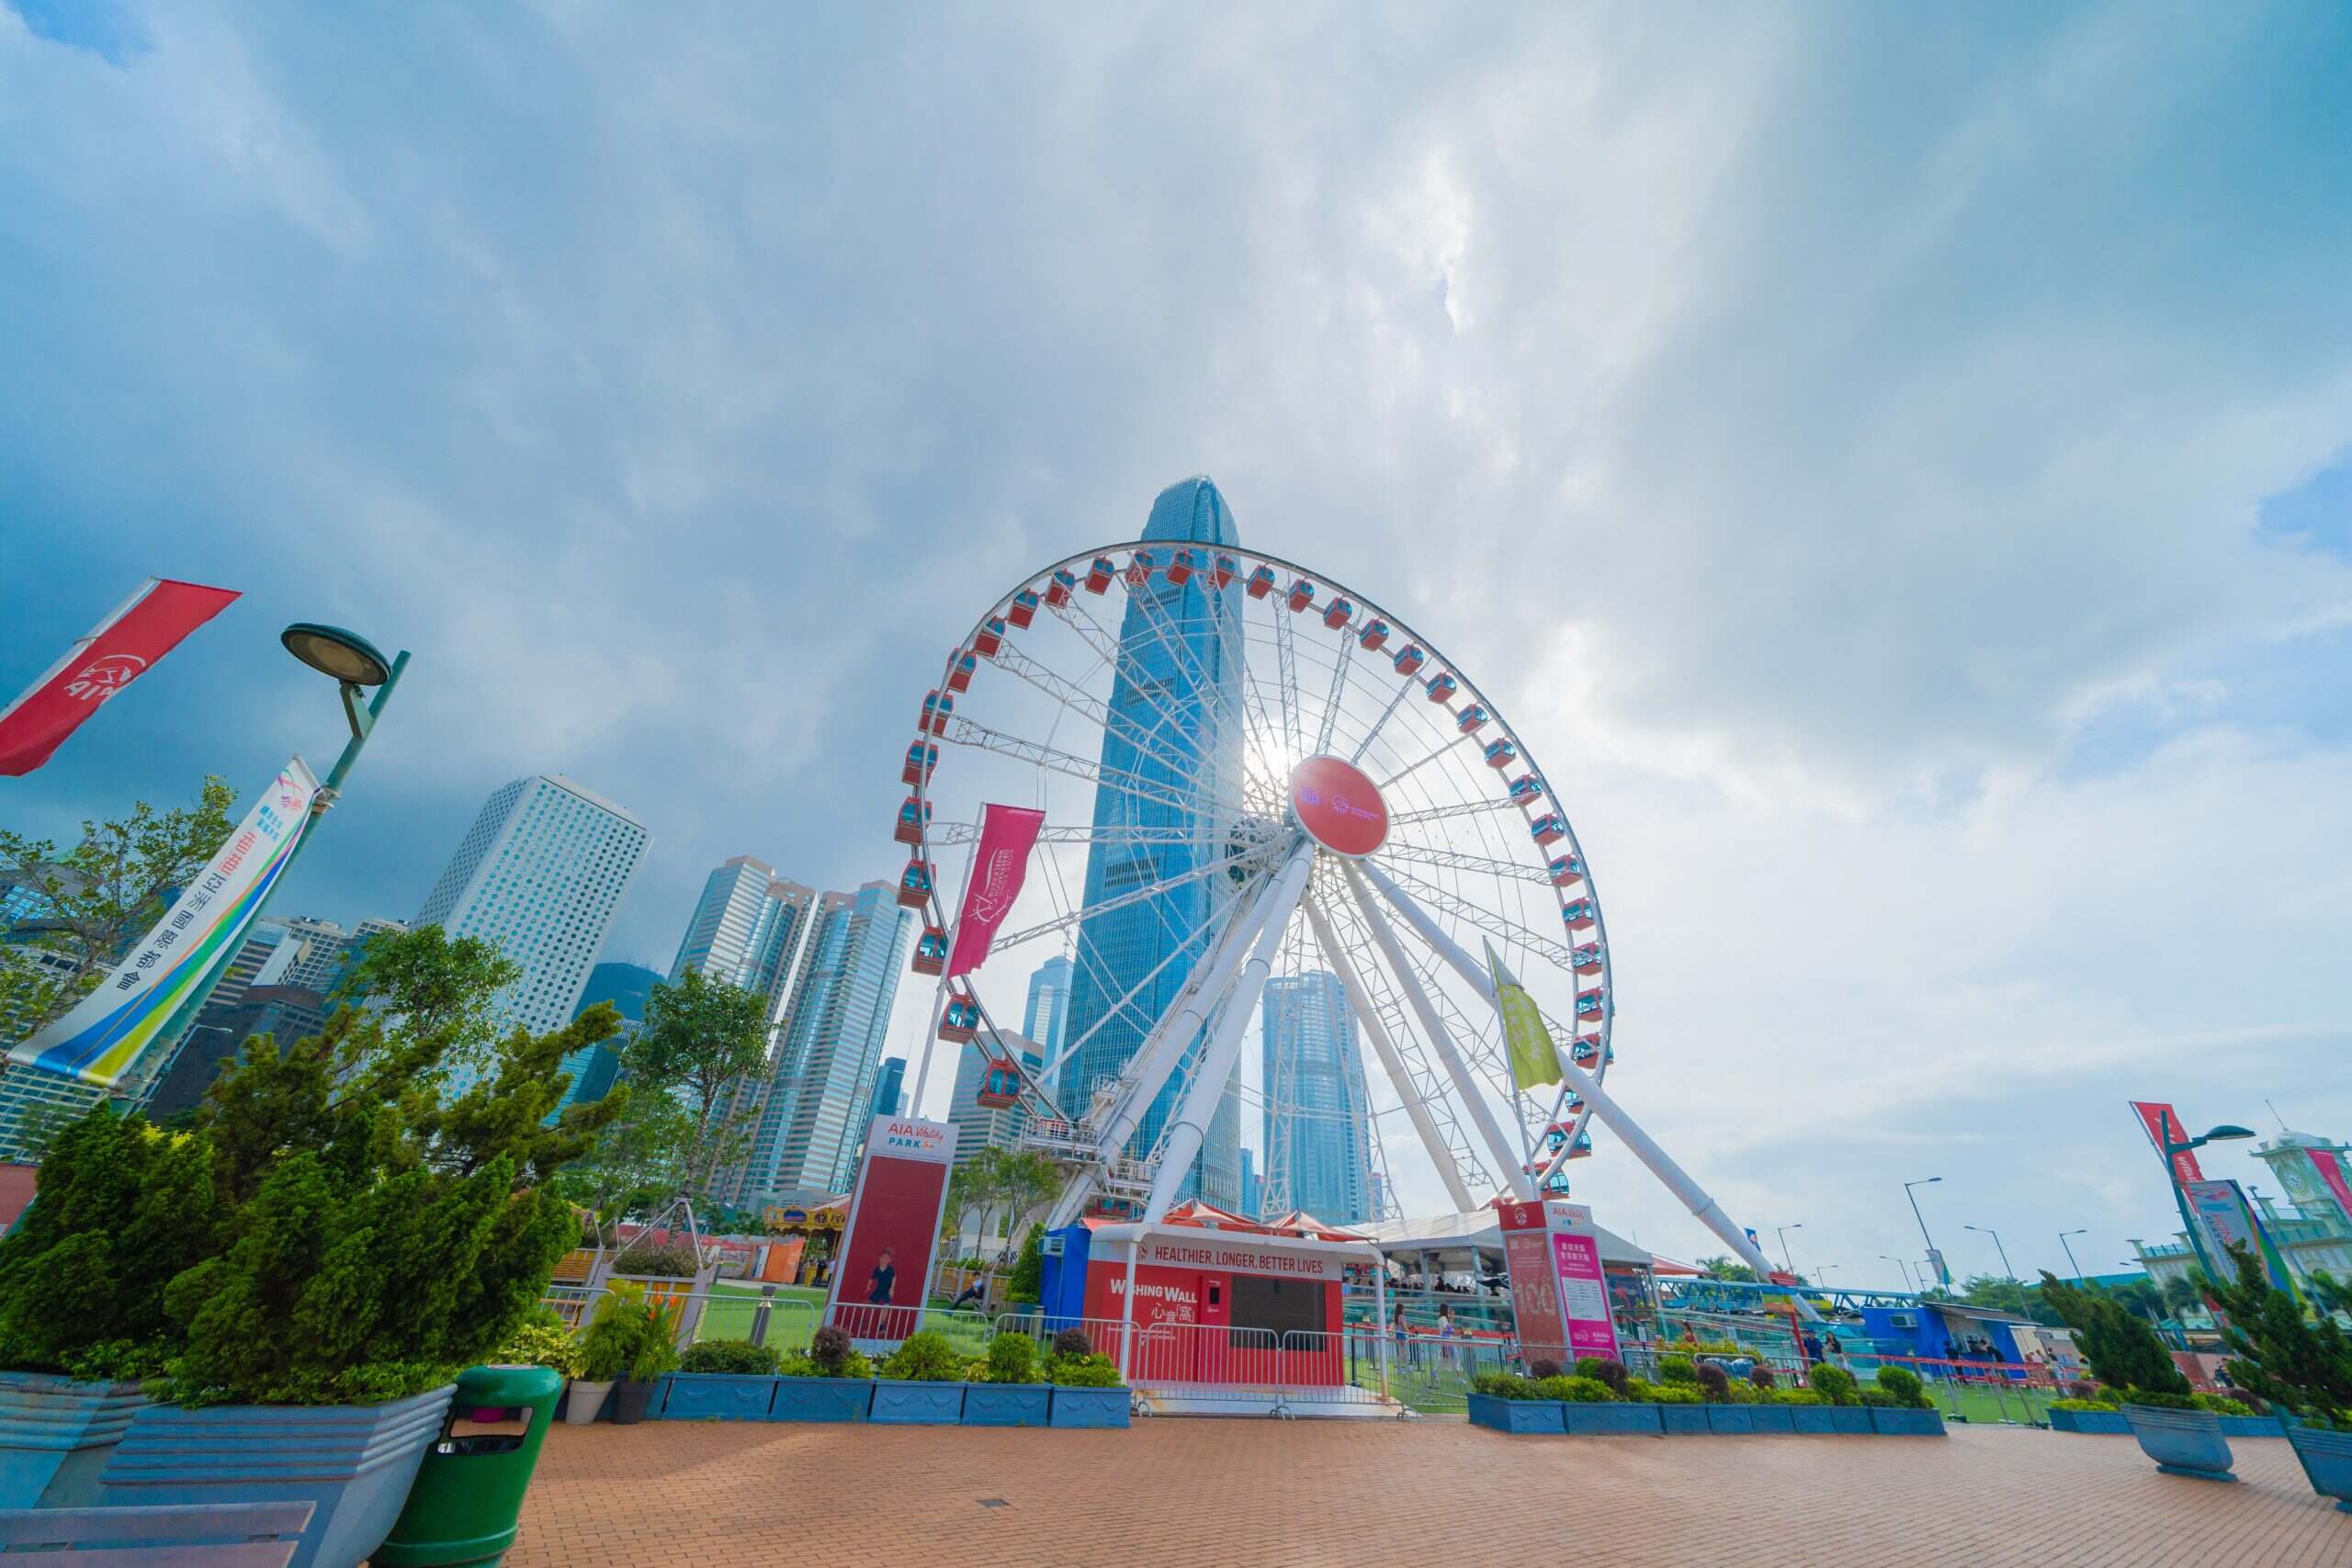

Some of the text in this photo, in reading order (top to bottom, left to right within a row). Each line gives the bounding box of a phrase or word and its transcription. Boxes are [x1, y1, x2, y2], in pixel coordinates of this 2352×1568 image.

[888, 1123, 944, 1142] AIA Vitality
[888, 1137, 920, 1148] PARK
[1155, 1246, 1214, 1265] HEALTHIER,
[1216, 1251, 1258, 1269] LONGER,
[1260, 1256, 1295, 1271] BETTER
[1297, 1258, 1323, 1273] LIVES
[1110, 1279, 1197, 1303] WHING WALL
[1513, 1282, 1557, 1316] 100
